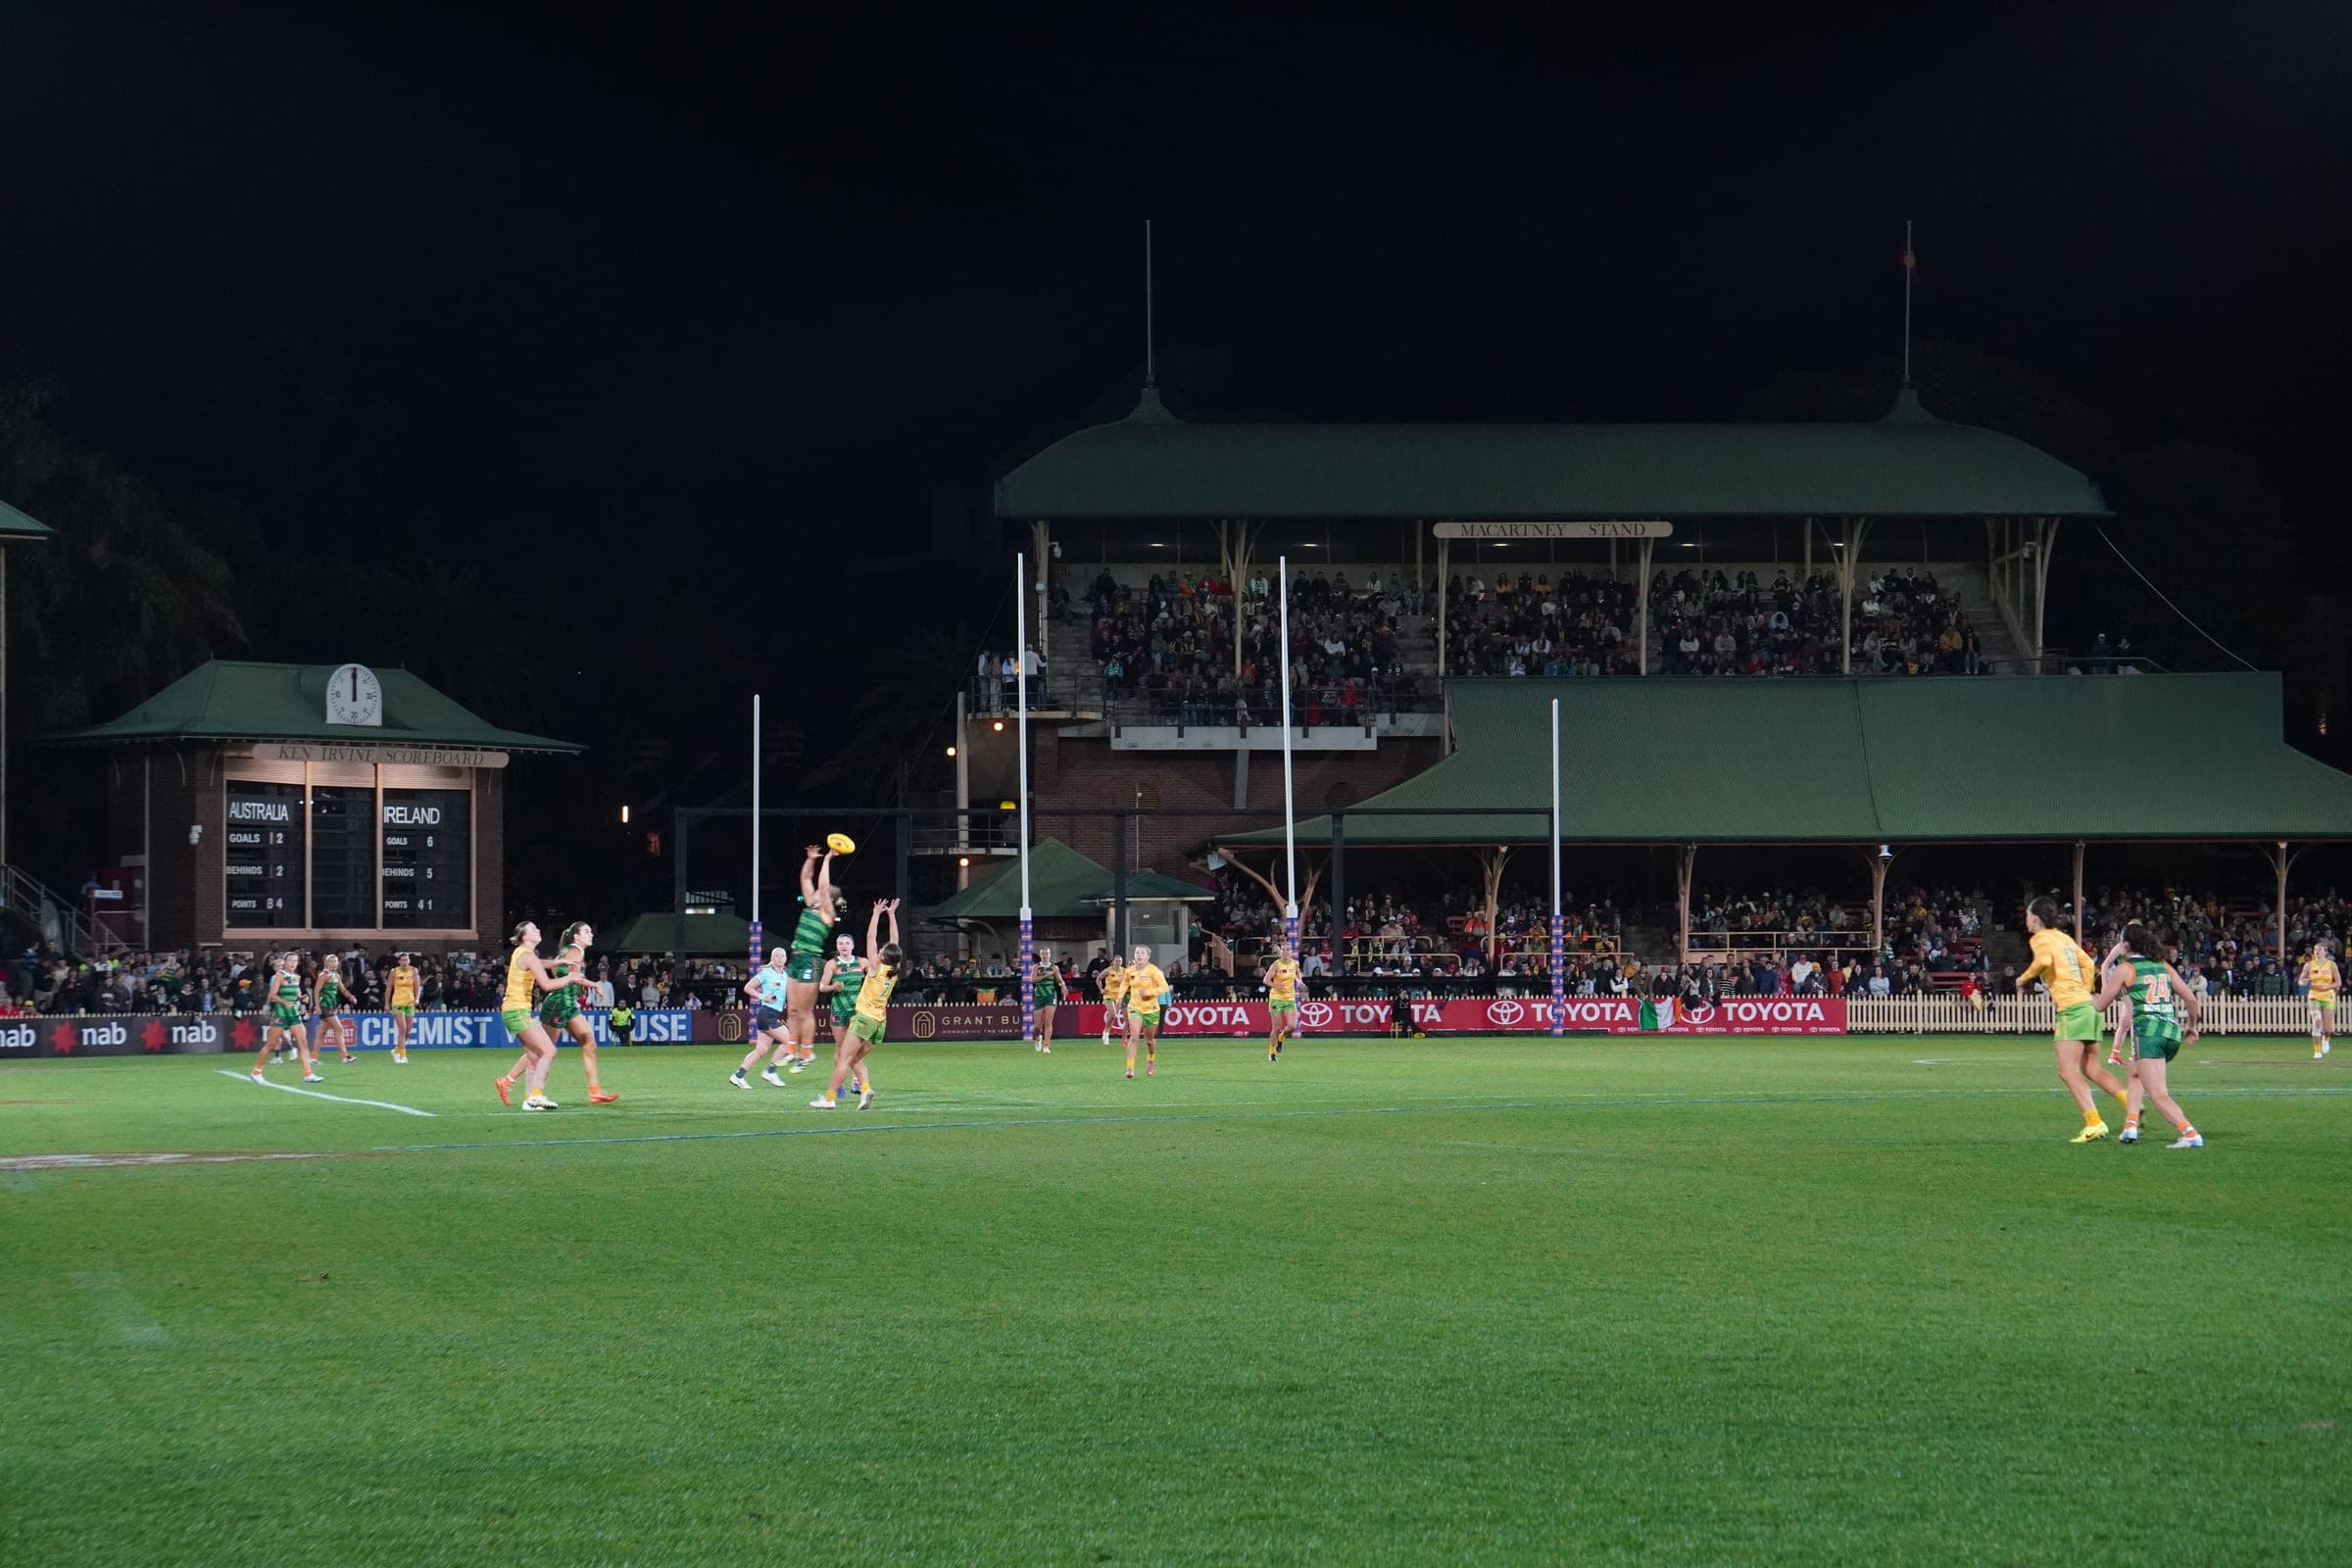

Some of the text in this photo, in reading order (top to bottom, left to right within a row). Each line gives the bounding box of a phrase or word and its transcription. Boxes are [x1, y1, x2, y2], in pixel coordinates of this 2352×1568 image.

[1460, 522, 1645, 537] MACARTNEY STAND
[279, 746, 484, 765] KEN IRVINE SCOREBOARD
[229, 802, 289, 821] AUSTRALIA
[383, 806, 440, 824] IRELAND
[229, 833, 261, 843] GOALS
[426, 835, 433, 847] 6
[226, 865, 263, 874] BEHINDS
[426, 867, 433, 879] 5
[231, 900, 257, 908] POINTS
[384, 901, 408, 909] POINTS
[2143, 974, 2170, 1004] 24
[1164, 1006, 1250, 1027] OYOTA
[1340, 1004, 1443, 1024] TOYTA
[1722, 1002, 1825, 1021] TOYOTA
[942, 1016, 994, 1026] GRANT
[81, 1021, 126, 1045] nab
[172, 1020, 217, 1043] nab
